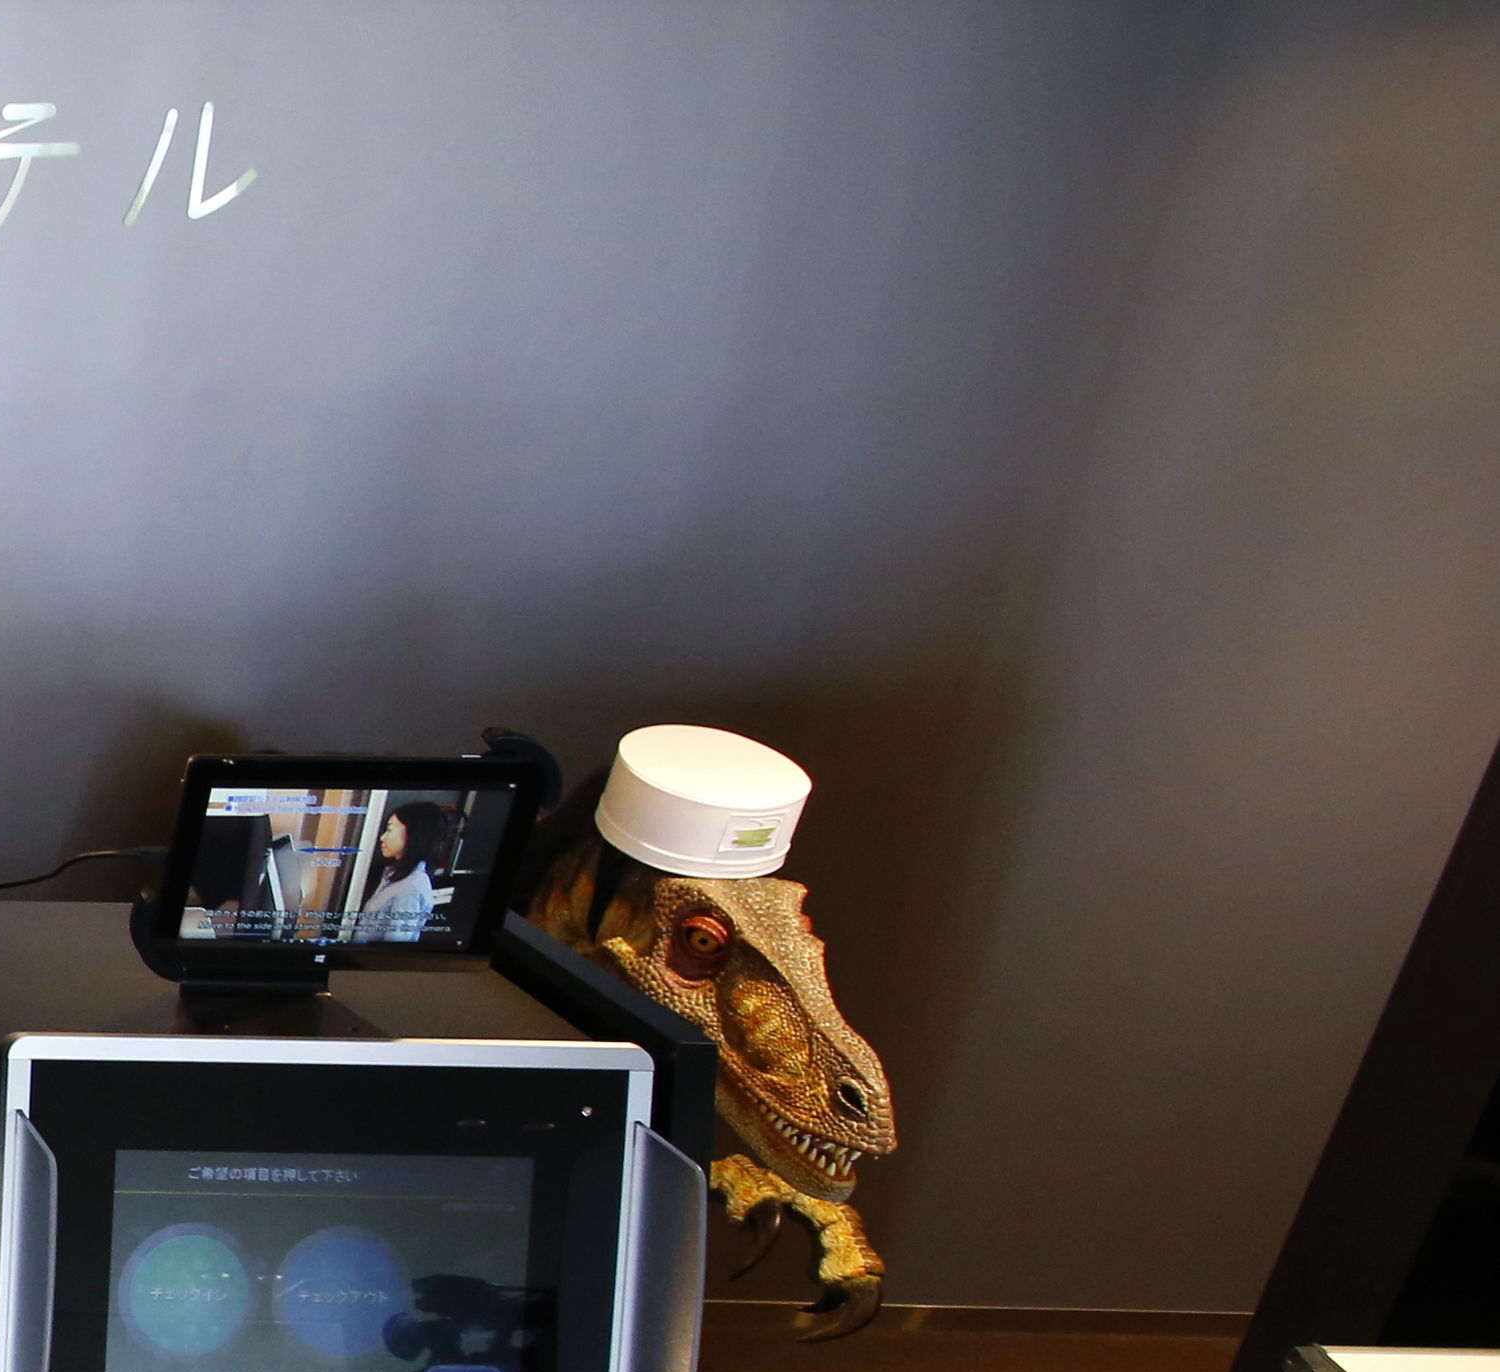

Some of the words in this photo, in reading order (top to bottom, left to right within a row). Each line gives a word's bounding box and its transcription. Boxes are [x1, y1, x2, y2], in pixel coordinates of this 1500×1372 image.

[187, 1165, 359, 1184] ご希望の項目を押して下さい
